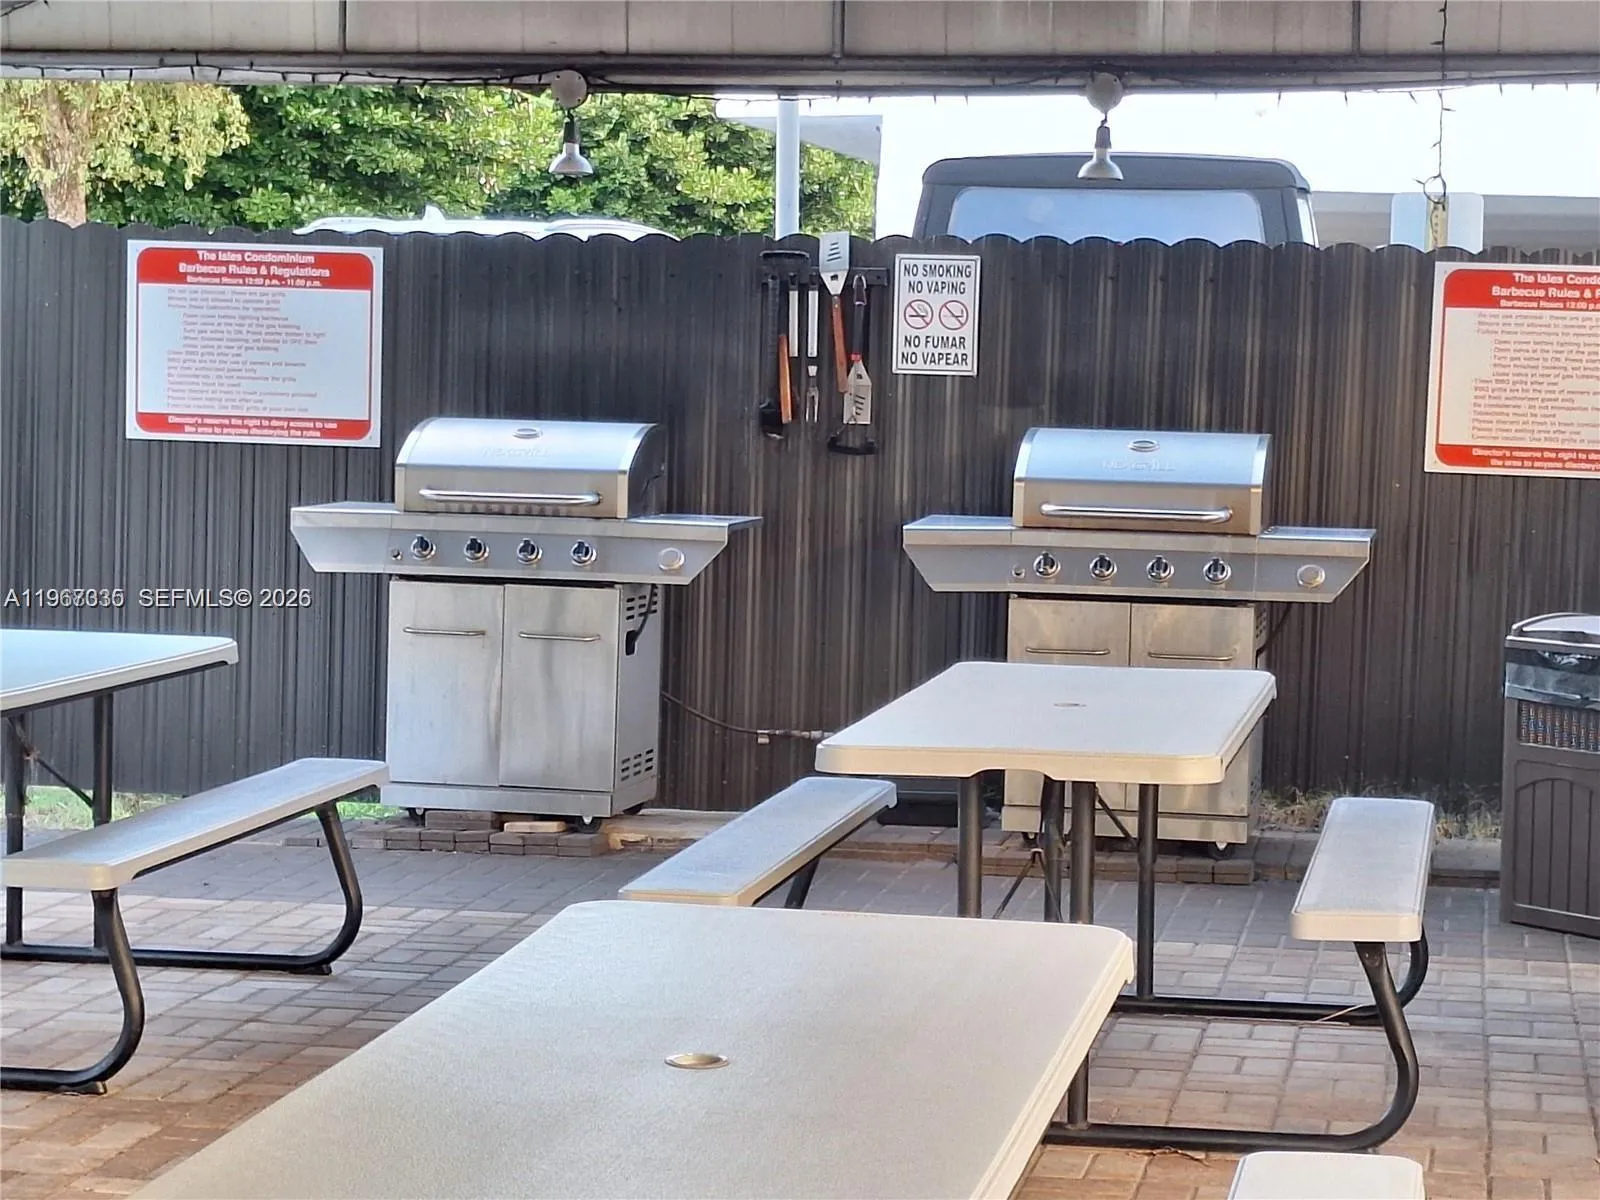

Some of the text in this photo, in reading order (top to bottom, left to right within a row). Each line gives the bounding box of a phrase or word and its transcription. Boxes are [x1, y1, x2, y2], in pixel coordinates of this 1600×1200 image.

[197, 250, 216, 261] The
[244, 252, 315, 264] Condominium
[179, 262, 227, 275] Barbecue
[229, 264, 258, 275] Rules
[270, 266, 330, 278] Regulations
[903, 264, 972, 278] NO SMOKING
[1513, 272, 1535, 283] The
[1537, 273, 1564, 284] Isles
[908, 281, 966, 295] NO VAPING
[1492, 285, 1545, 297] Barbecue
[1548, 287, 1580, 298] Rules
[904, 335, 966, 349] NO FUMAR
[901, 352, 969, 366] NO VAPEAR
